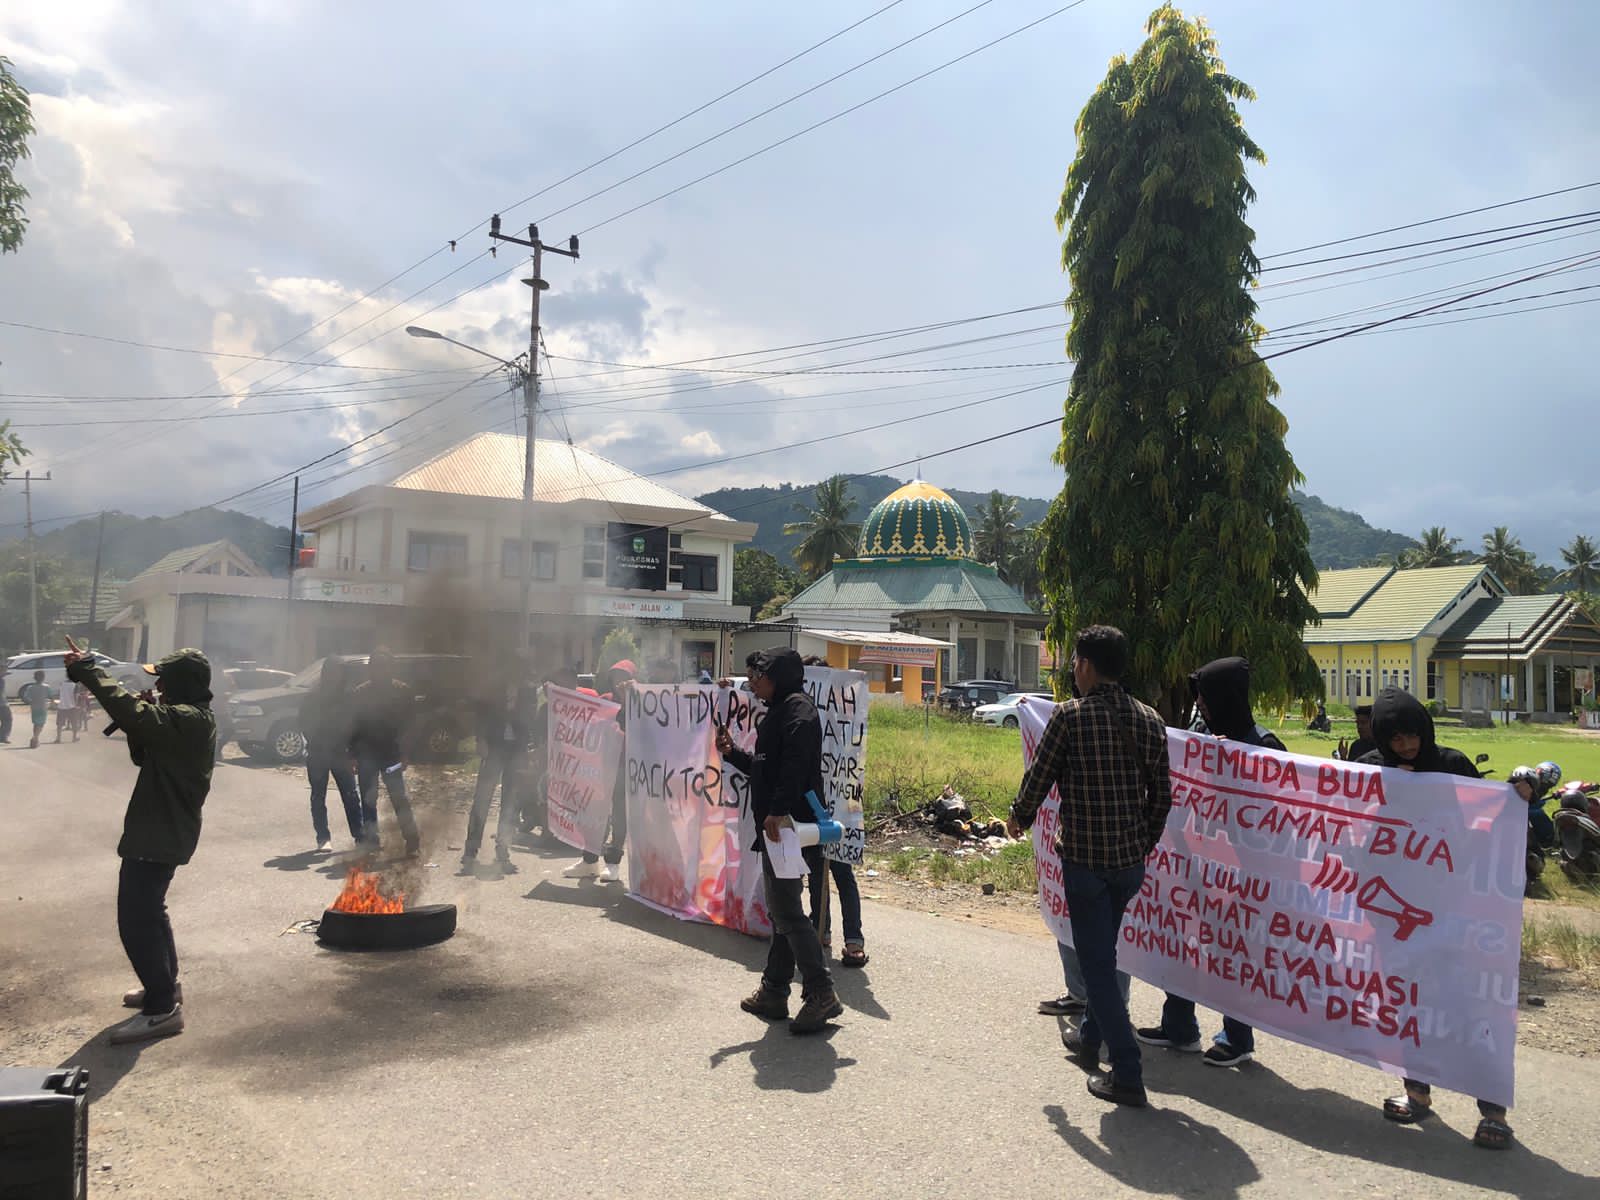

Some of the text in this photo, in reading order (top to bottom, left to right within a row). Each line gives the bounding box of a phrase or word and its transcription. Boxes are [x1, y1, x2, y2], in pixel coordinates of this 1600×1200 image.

[552, 699, 598, 723] CAMAT
[803, 680, 856, 715] ALAH
[555, 722, 585, 748] BUA
[628, 758, 675, 800] BACK
[1184, 737, 1387, 806] PEMUDA BUA
[1236, 804, 1352, 846] CAMAT
[1369, 826, 1454, 873] BUA
[1203, 863, 1271, 903] LUWU
[1170, 886, 1261, 930] CAMAT
[1268, 911, 1338, 955] BUA
[1123, 925, 1200, 969] OKNUM
[1207, 953, 1309, 1014] KEPALA
[1326, 995, 1421, 1048] DESA
[1200, 921, 1249, 958] BUA
[1264, 947, 1419, 1007] EVALUASI
